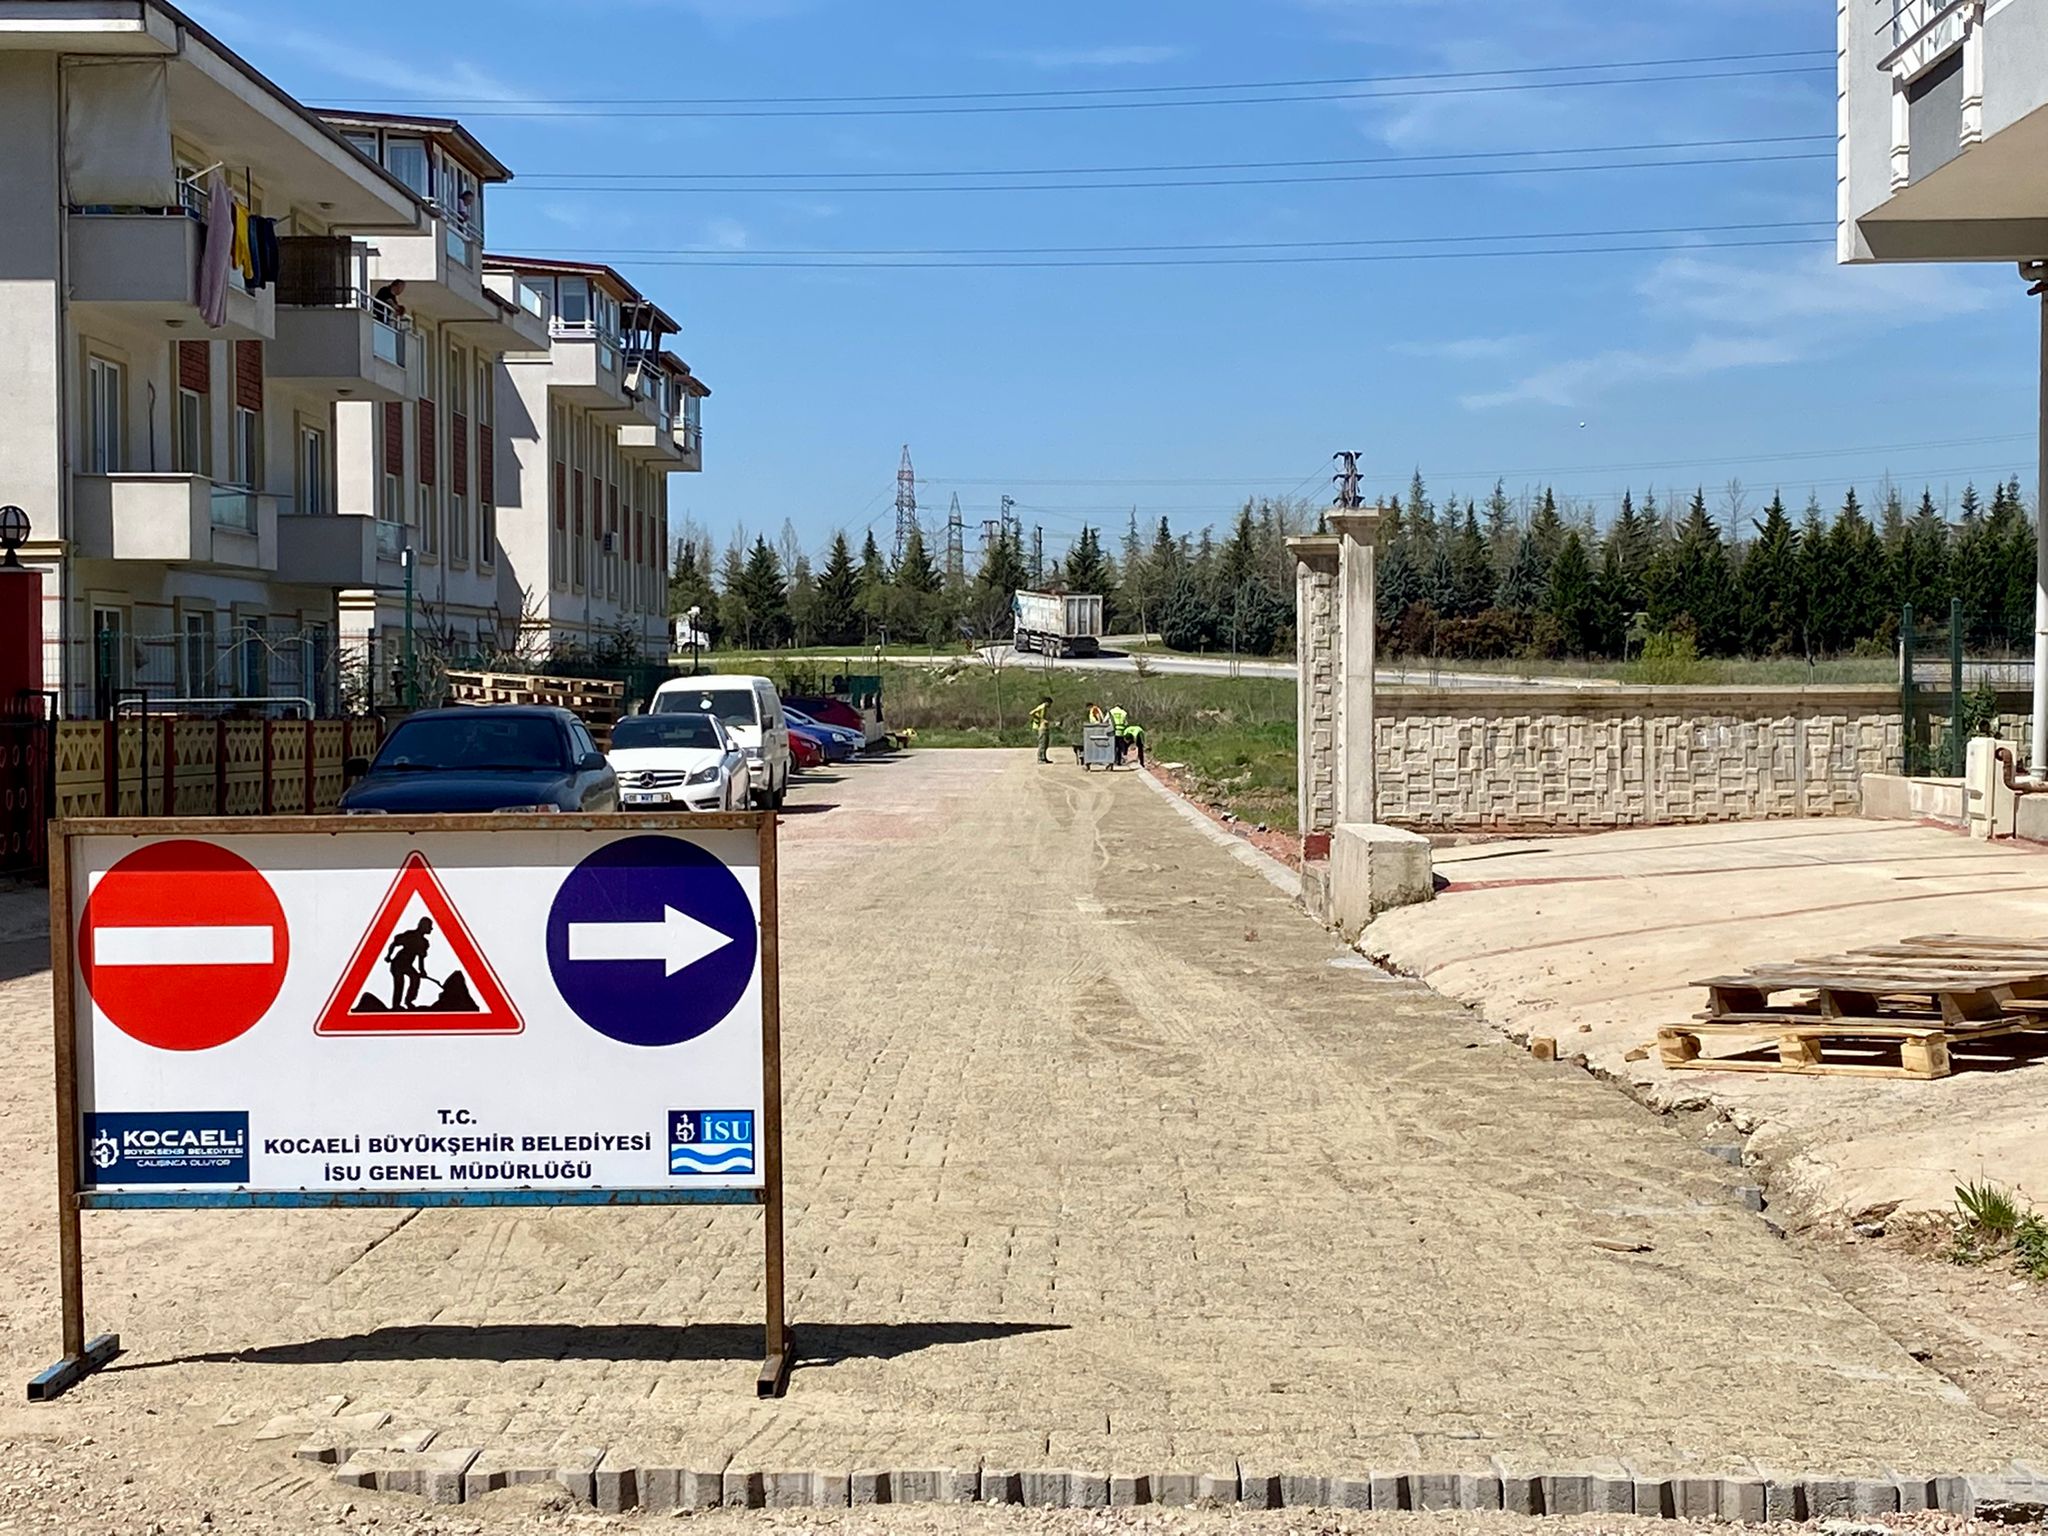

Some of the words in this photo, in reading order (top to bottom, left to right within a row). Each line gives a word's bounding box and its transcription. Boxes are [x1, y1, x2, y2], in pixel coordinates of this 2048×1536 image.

[437, 1109, 477, 1125] T.C.
[703, 1116, 751, 1141] İSU
[264, 1133, 360, 1154] KOCAELİ
[368, 1132, 515, 1157] BÜYÜKŞEHİR
[521, 1131, 651, 1152] BELEDİYESİ
[324, 1163, 361, 1182] İSU
[368, 1164, 443, 1181] GENEL
[450, 1160, 592, 1180] MÜDÜRLÜĞÜ
